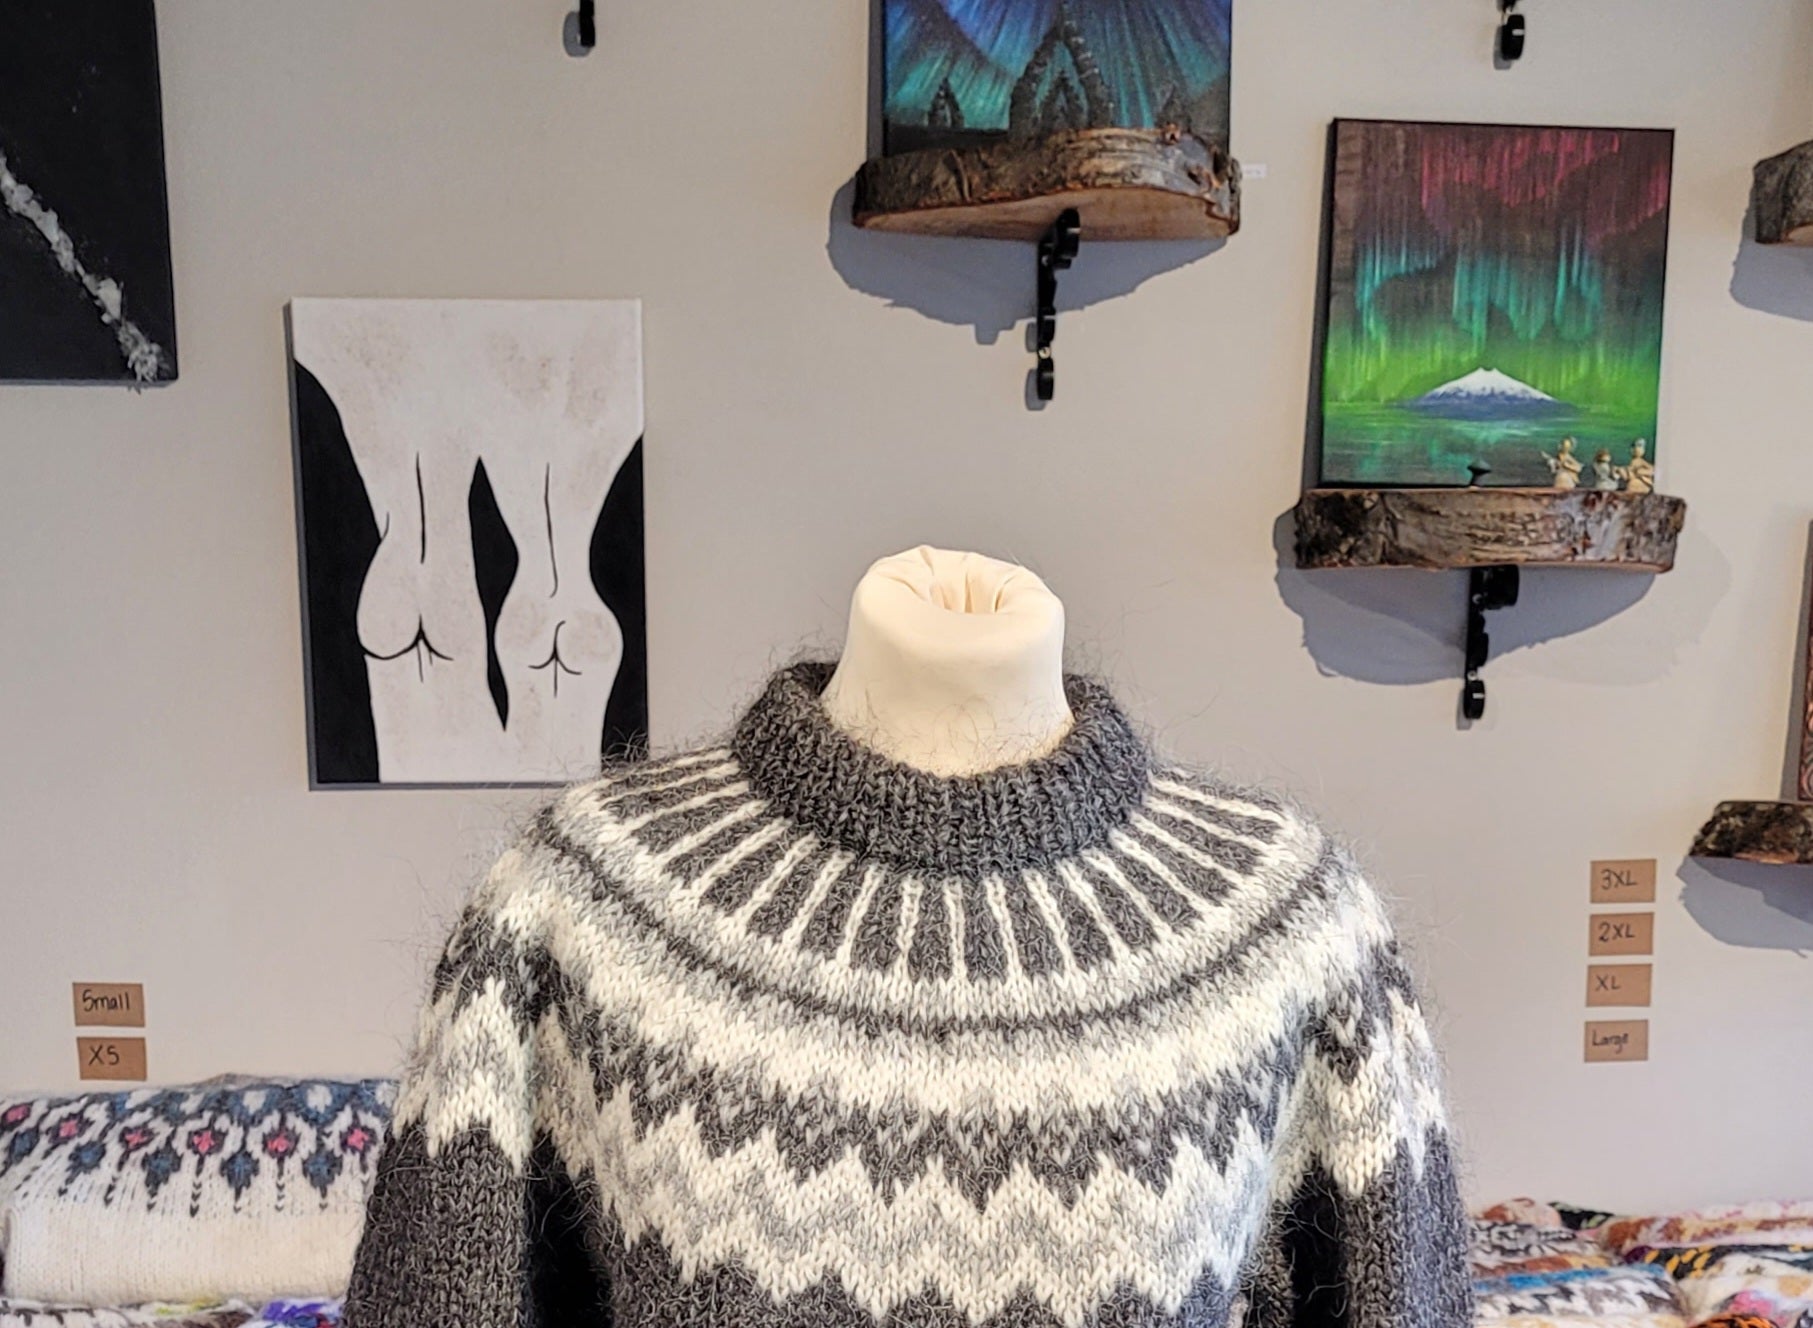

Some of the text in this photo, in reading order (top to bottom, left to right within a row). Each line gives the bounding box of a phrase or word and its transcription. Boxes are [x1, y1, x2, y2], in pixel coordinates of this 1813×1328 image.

[1601, 868, 1637, 890] 3XL
[1598, 922, 1635, 943] 2XL
[1595, 975, 1621, 991] XL
[82, 989, 130, 1012] Small
[1592, 1030, 1629, 1054] Large
[88, 1044, 120, 1066] XS
